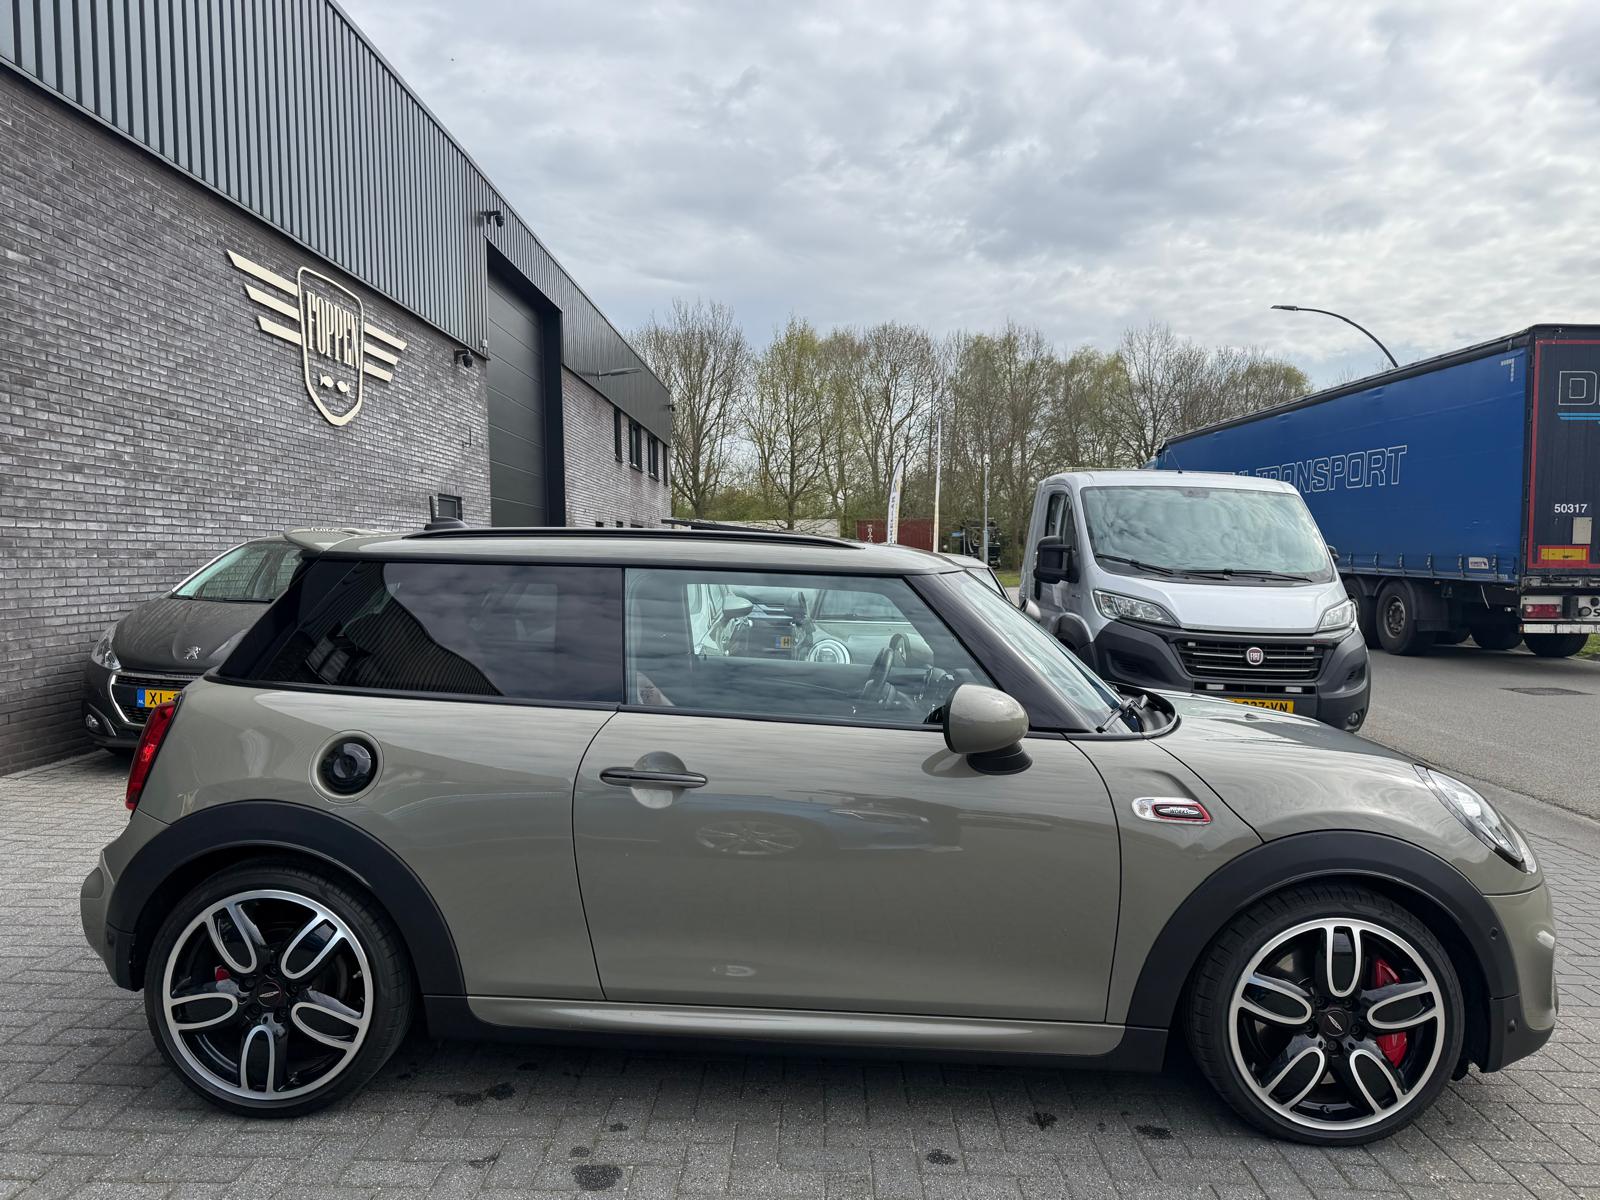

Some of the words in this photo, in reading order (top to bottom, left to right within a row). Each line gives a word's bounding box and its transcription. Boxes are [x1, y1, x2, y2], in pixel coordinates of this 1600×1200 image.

[306, 291, 360, 369] FOPPEN
[1255, 445, 1408, 493] ANSPORT
[1554, 503, 1588, 513] 50317
